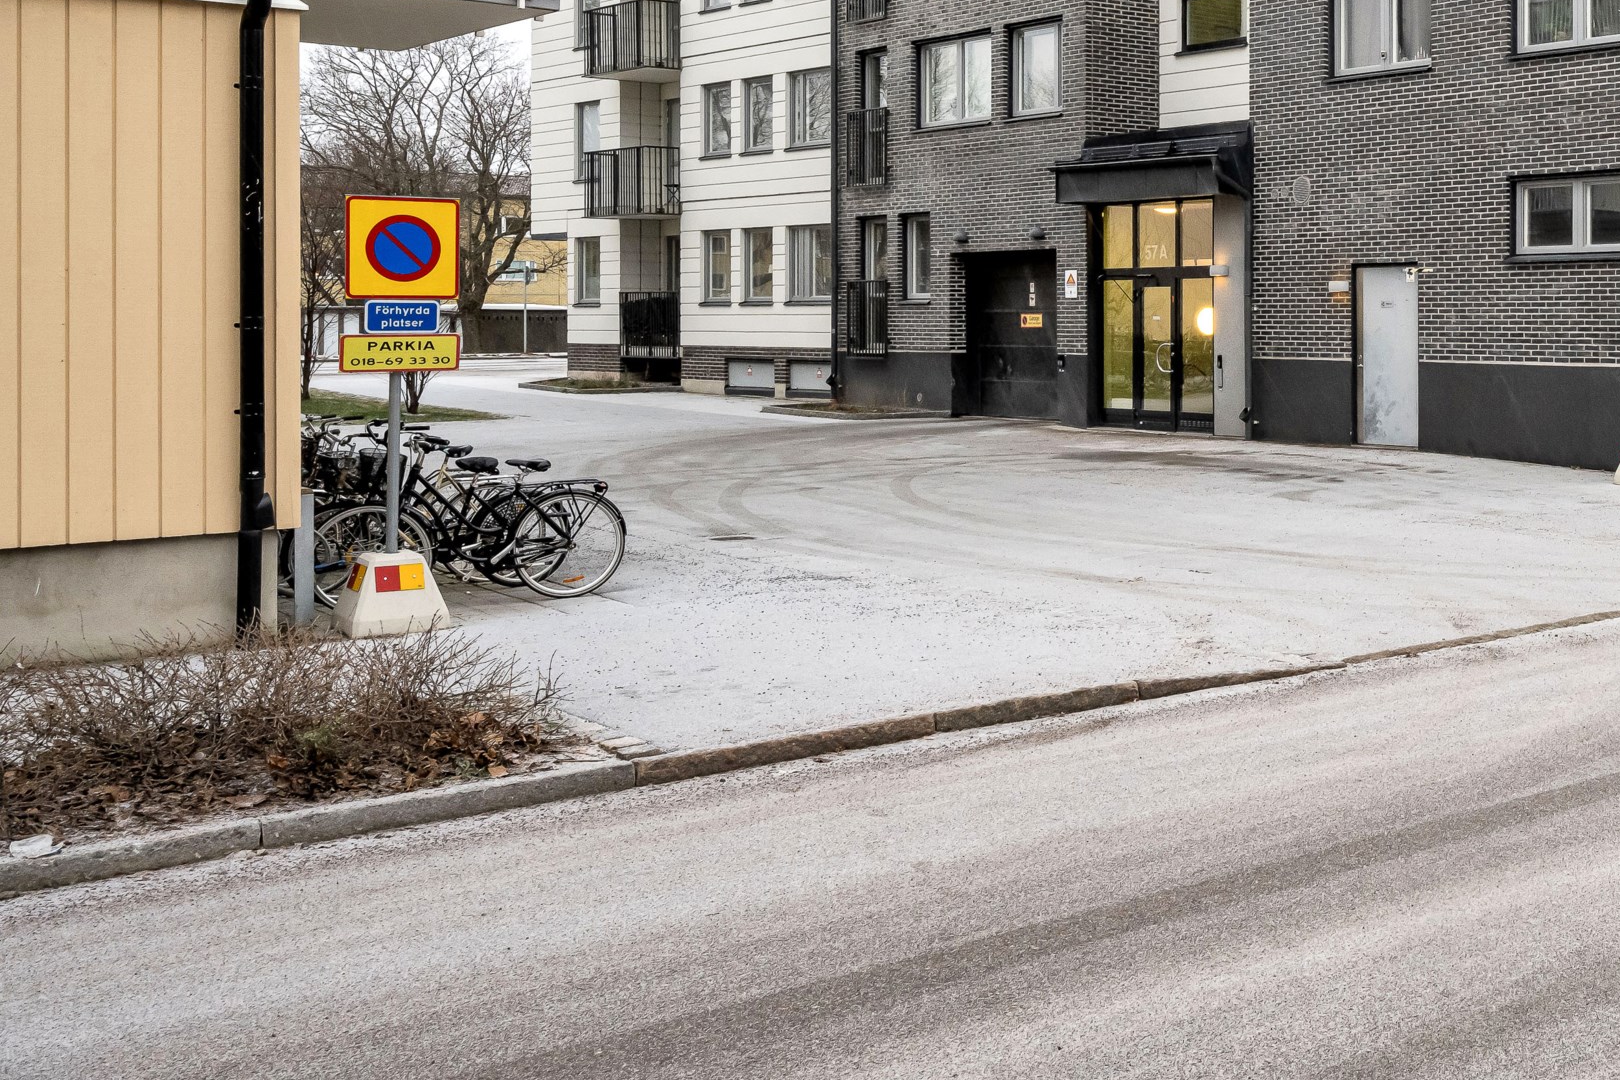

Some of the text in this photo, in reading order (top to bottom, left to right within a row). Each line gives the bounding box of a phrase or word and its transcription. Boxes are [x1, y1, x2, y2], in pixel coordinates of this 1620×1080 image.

[375, 305, 430, 317] Förhyrda
[381, 319, 424, 329] platser
[367, 340, 435, 351] PARKIA
[350, 356, 451, 366] 018-69 33 30
